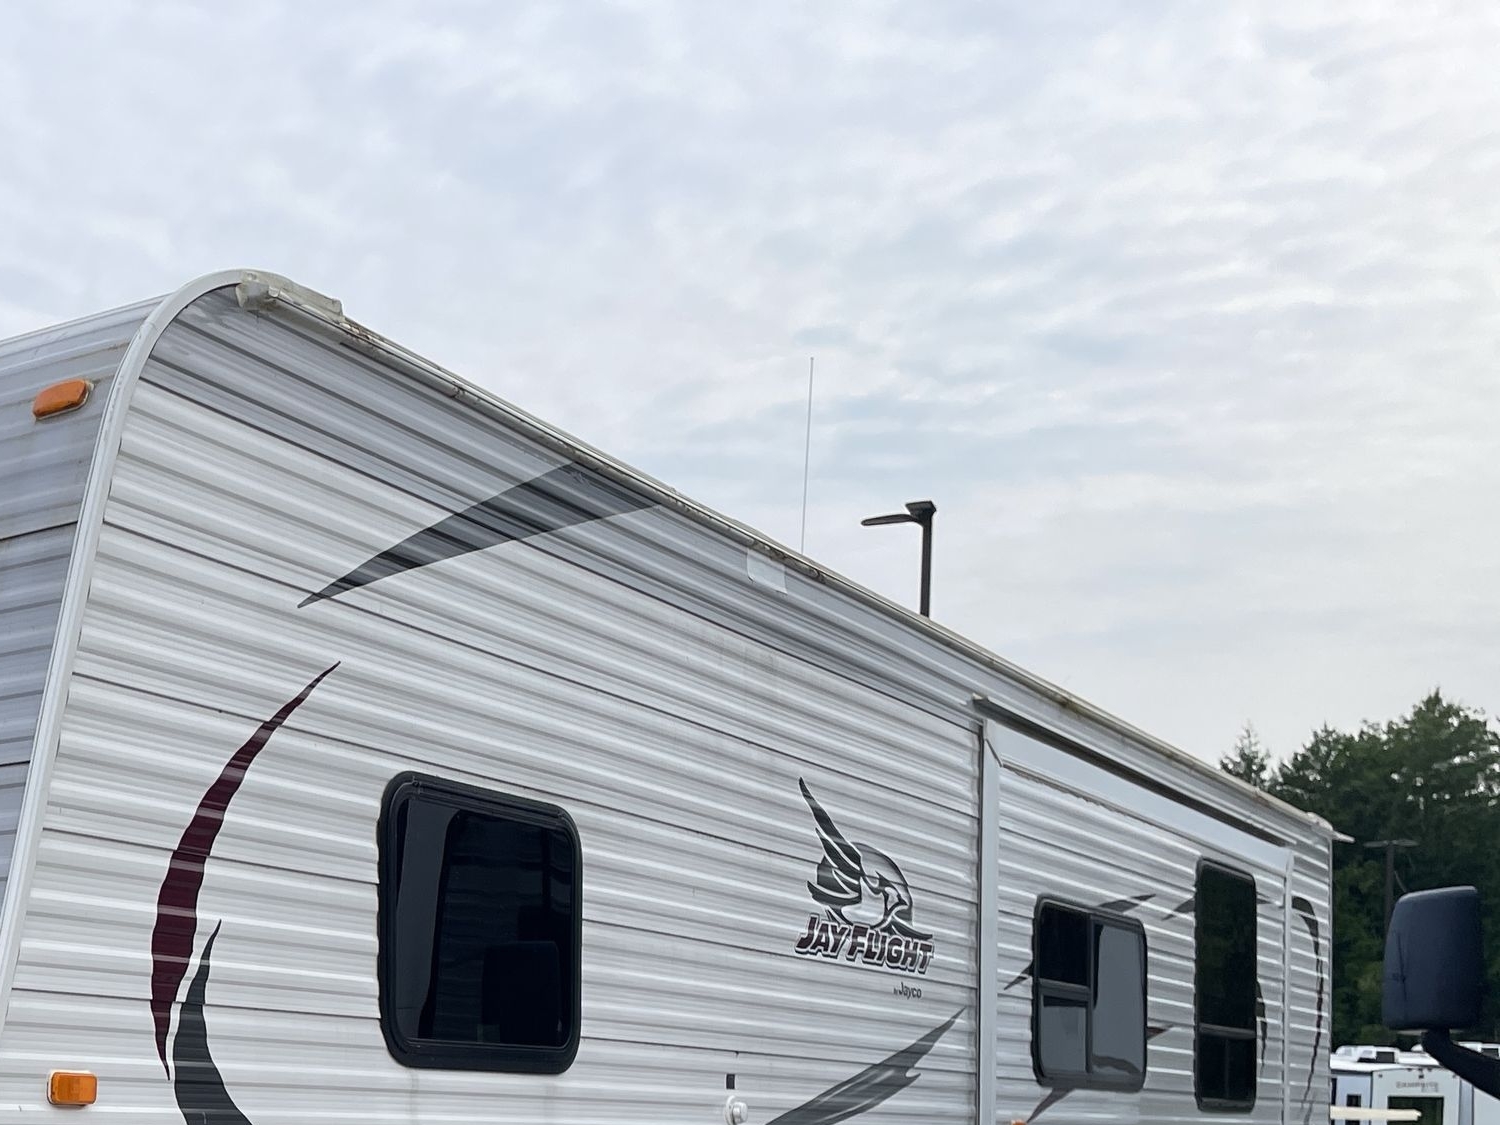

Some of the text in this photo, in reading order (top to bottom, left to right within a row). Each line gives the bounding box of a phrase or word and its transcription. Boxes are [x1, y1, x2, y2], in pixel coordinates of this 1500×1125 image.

[796, 914, 934, 973] JAY FLIGHT
[899, 981, 922, 1000] Jayco
